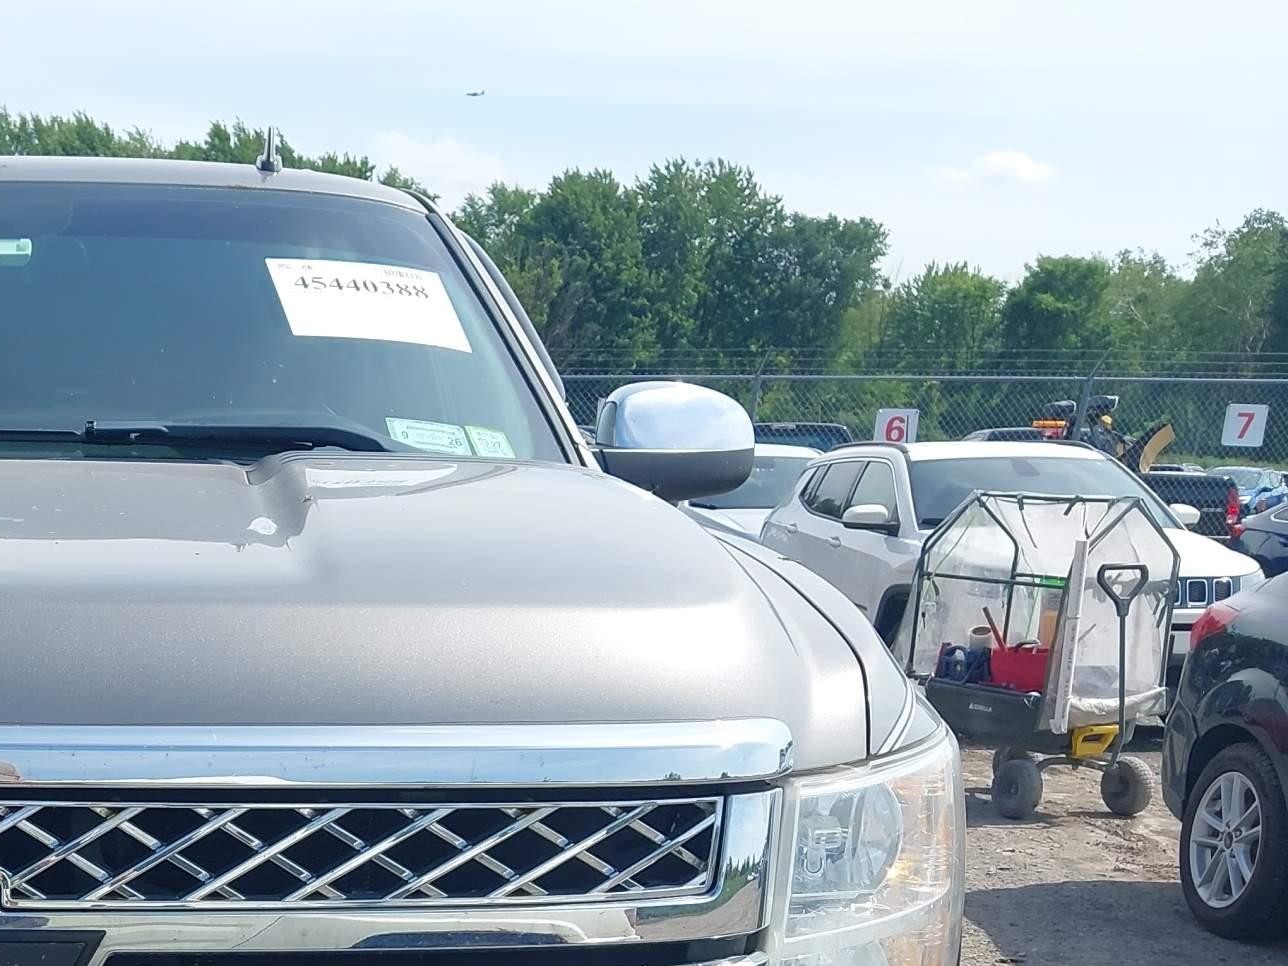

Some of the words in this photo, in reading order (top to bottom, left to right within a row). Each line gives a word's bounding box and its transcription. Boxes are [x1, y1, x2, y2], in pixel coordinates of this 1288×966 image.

[294, 275, 429, 299] 45440388
[885, 415, 906, 443] 6
[1237, 412, 1257, 439] 7
